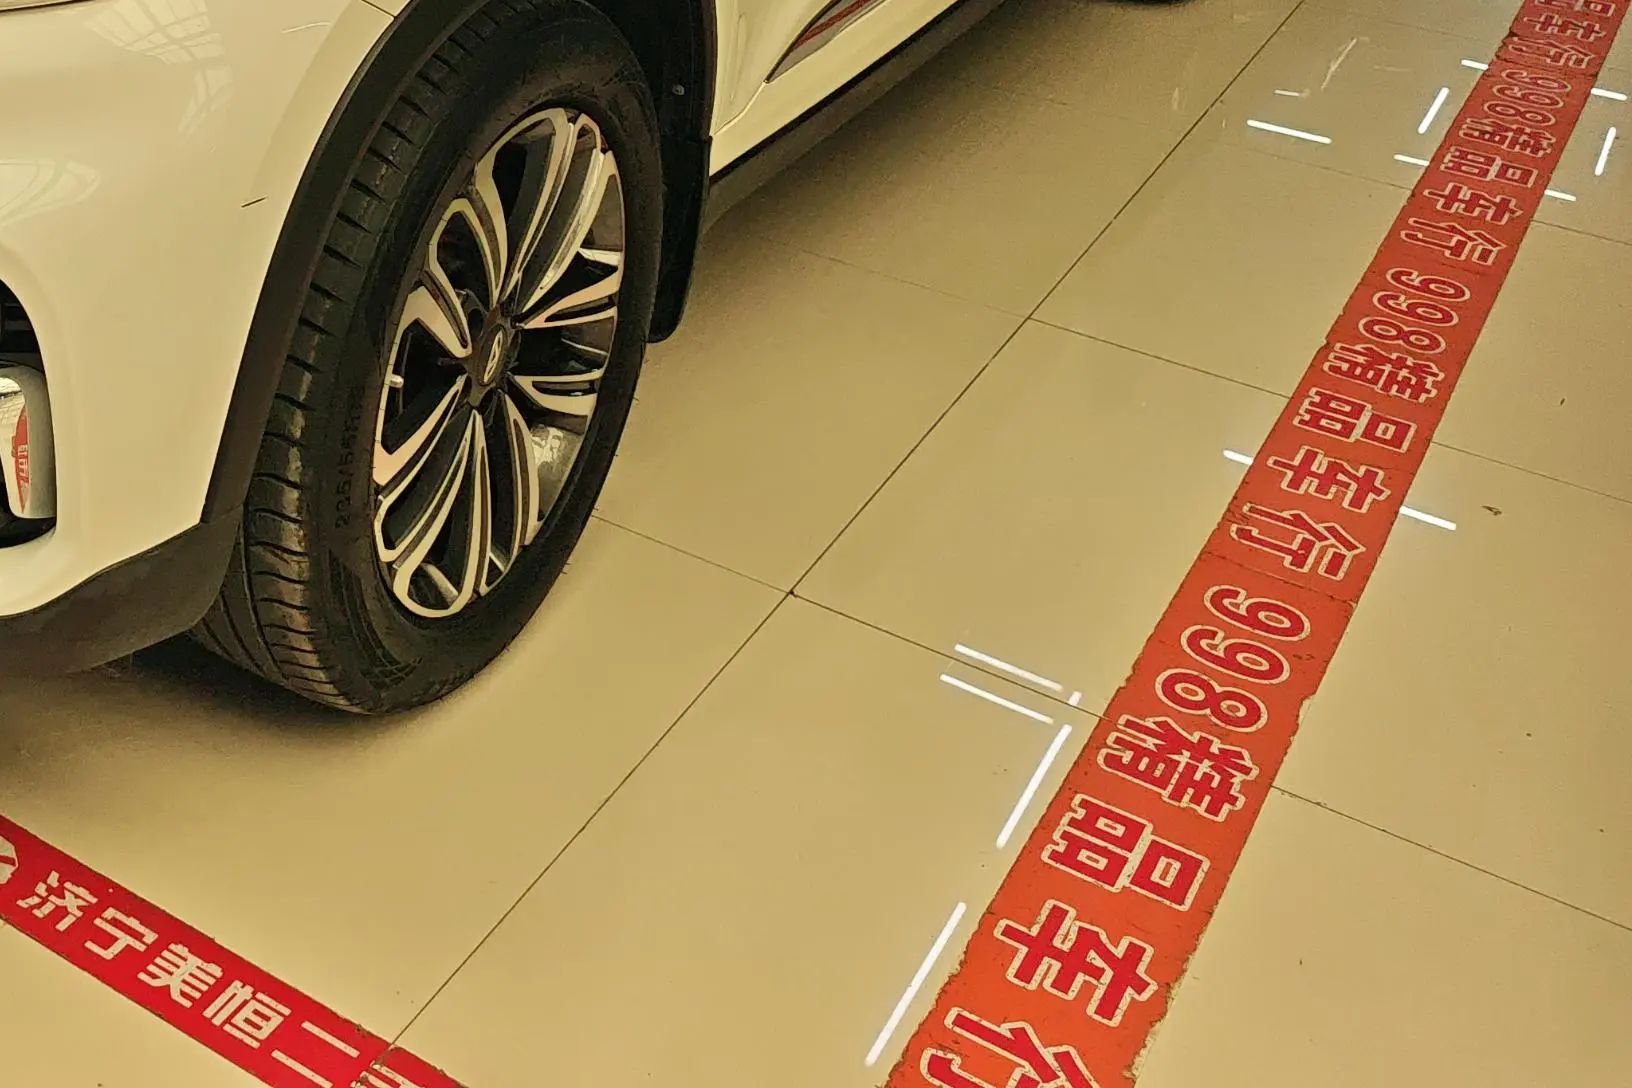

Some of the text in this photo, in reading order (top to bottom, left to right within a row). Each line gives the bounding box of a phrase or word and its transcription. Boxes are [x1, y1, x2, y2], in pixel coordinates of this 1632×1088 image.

[1399, 68, 1572, 266] 998精品车行
[1229, 267, 1472, 581] 998精品车行
[919, 584, 1312, 1088] 998精品车行
